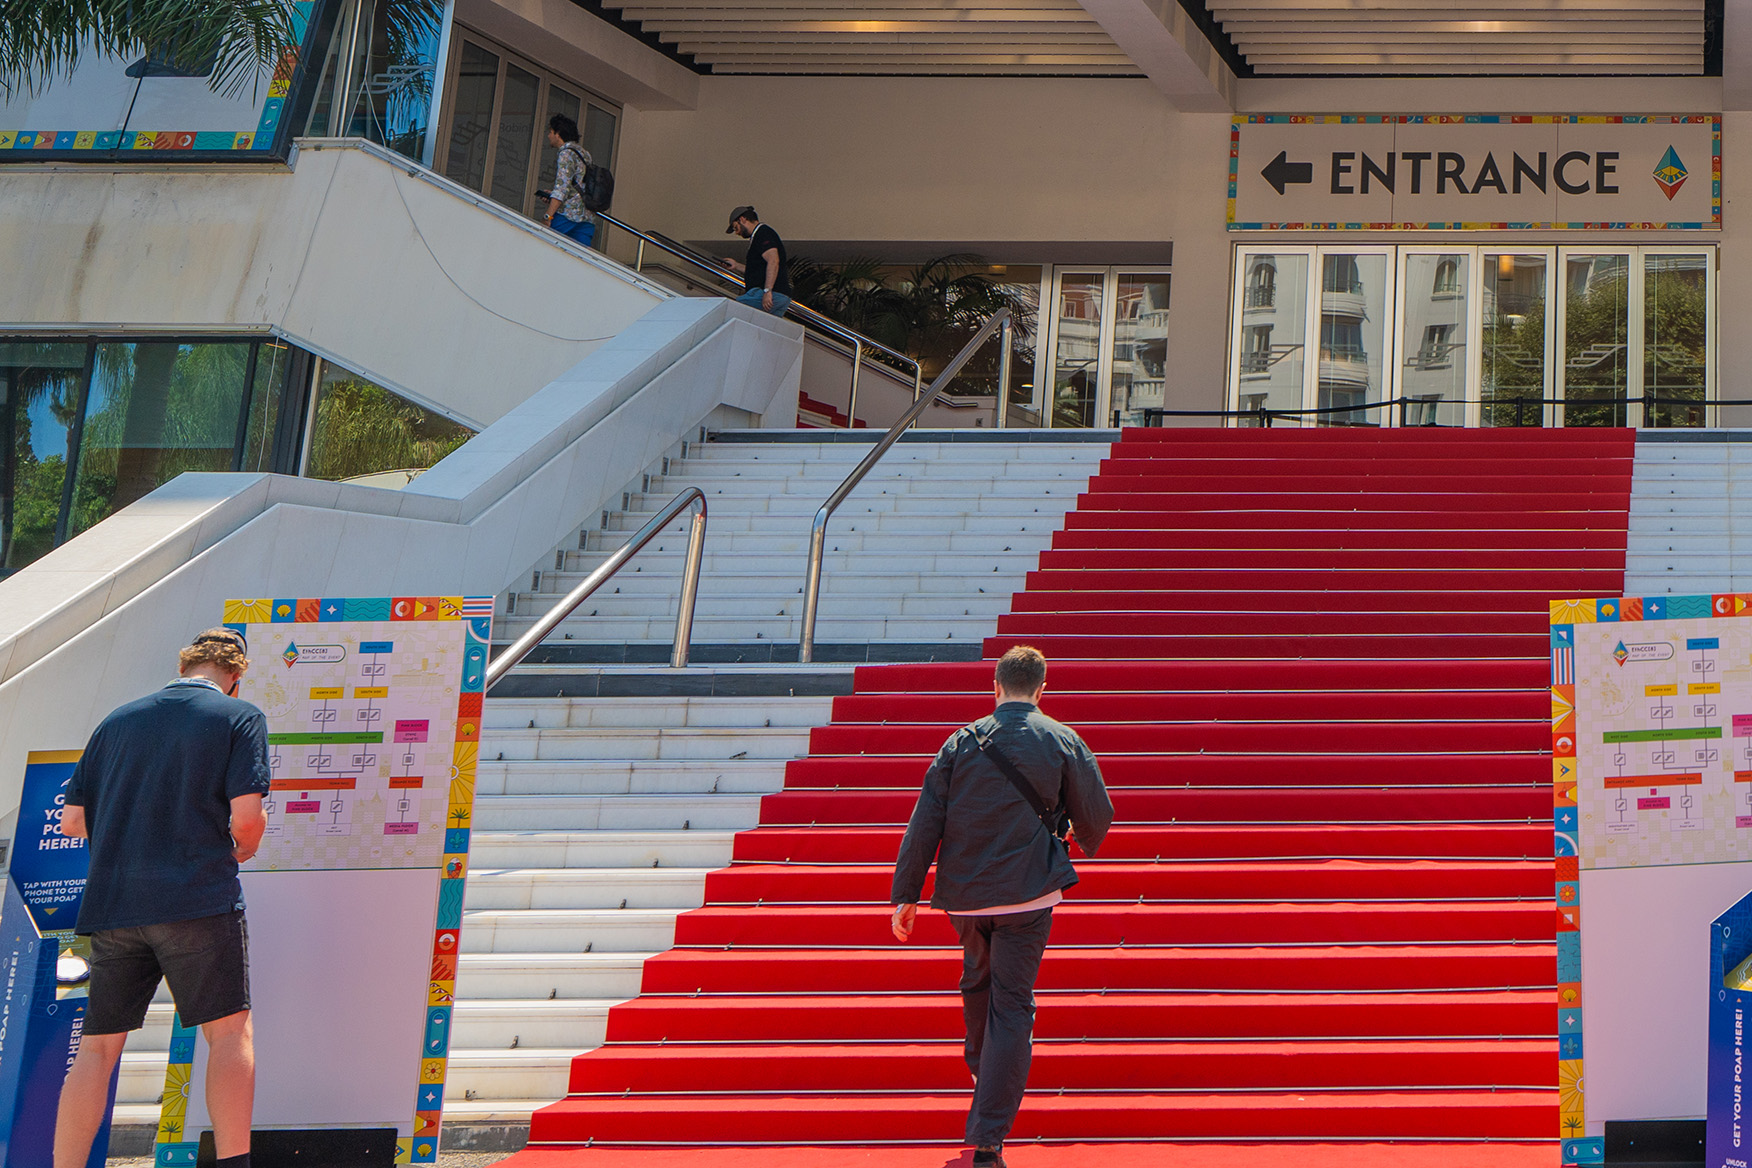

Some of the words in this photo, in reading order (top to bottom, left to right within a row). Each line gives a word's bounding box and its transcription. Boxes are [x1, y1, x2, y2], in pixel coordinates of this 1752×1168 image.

[1330, 150, 1620, 196] ENTRANCE
[44, 809, 63, 821] YO
[42, 824, 62, 836] PO
[38, 837, 85, 851] HERE!
[23, 881, 40, 890] TAP
[40, 880, 63, 889] WITH
[63, 879, 87, 887] YOUR
[24, 888, 54, 897] PHONE
[54, 887, 67, 895] TO
[67, 886, 84, 894] GET
[29, 896, 53, 905] YOUR
[53, 895, 77, 903] POAP
[5, 950, 20, 1001] HERE!
[68, 1017, 84, 1055] HERE!
[1735, 1008, 1743, 1047] HERE!
[1734, 1048, 1743, 1083] POAP
[1734, 1084, 1742, 1122] YOUR
[1733, 1122, 1742, 1148] GET
[1725, 1157, 1748, 1168] UNLOCK
